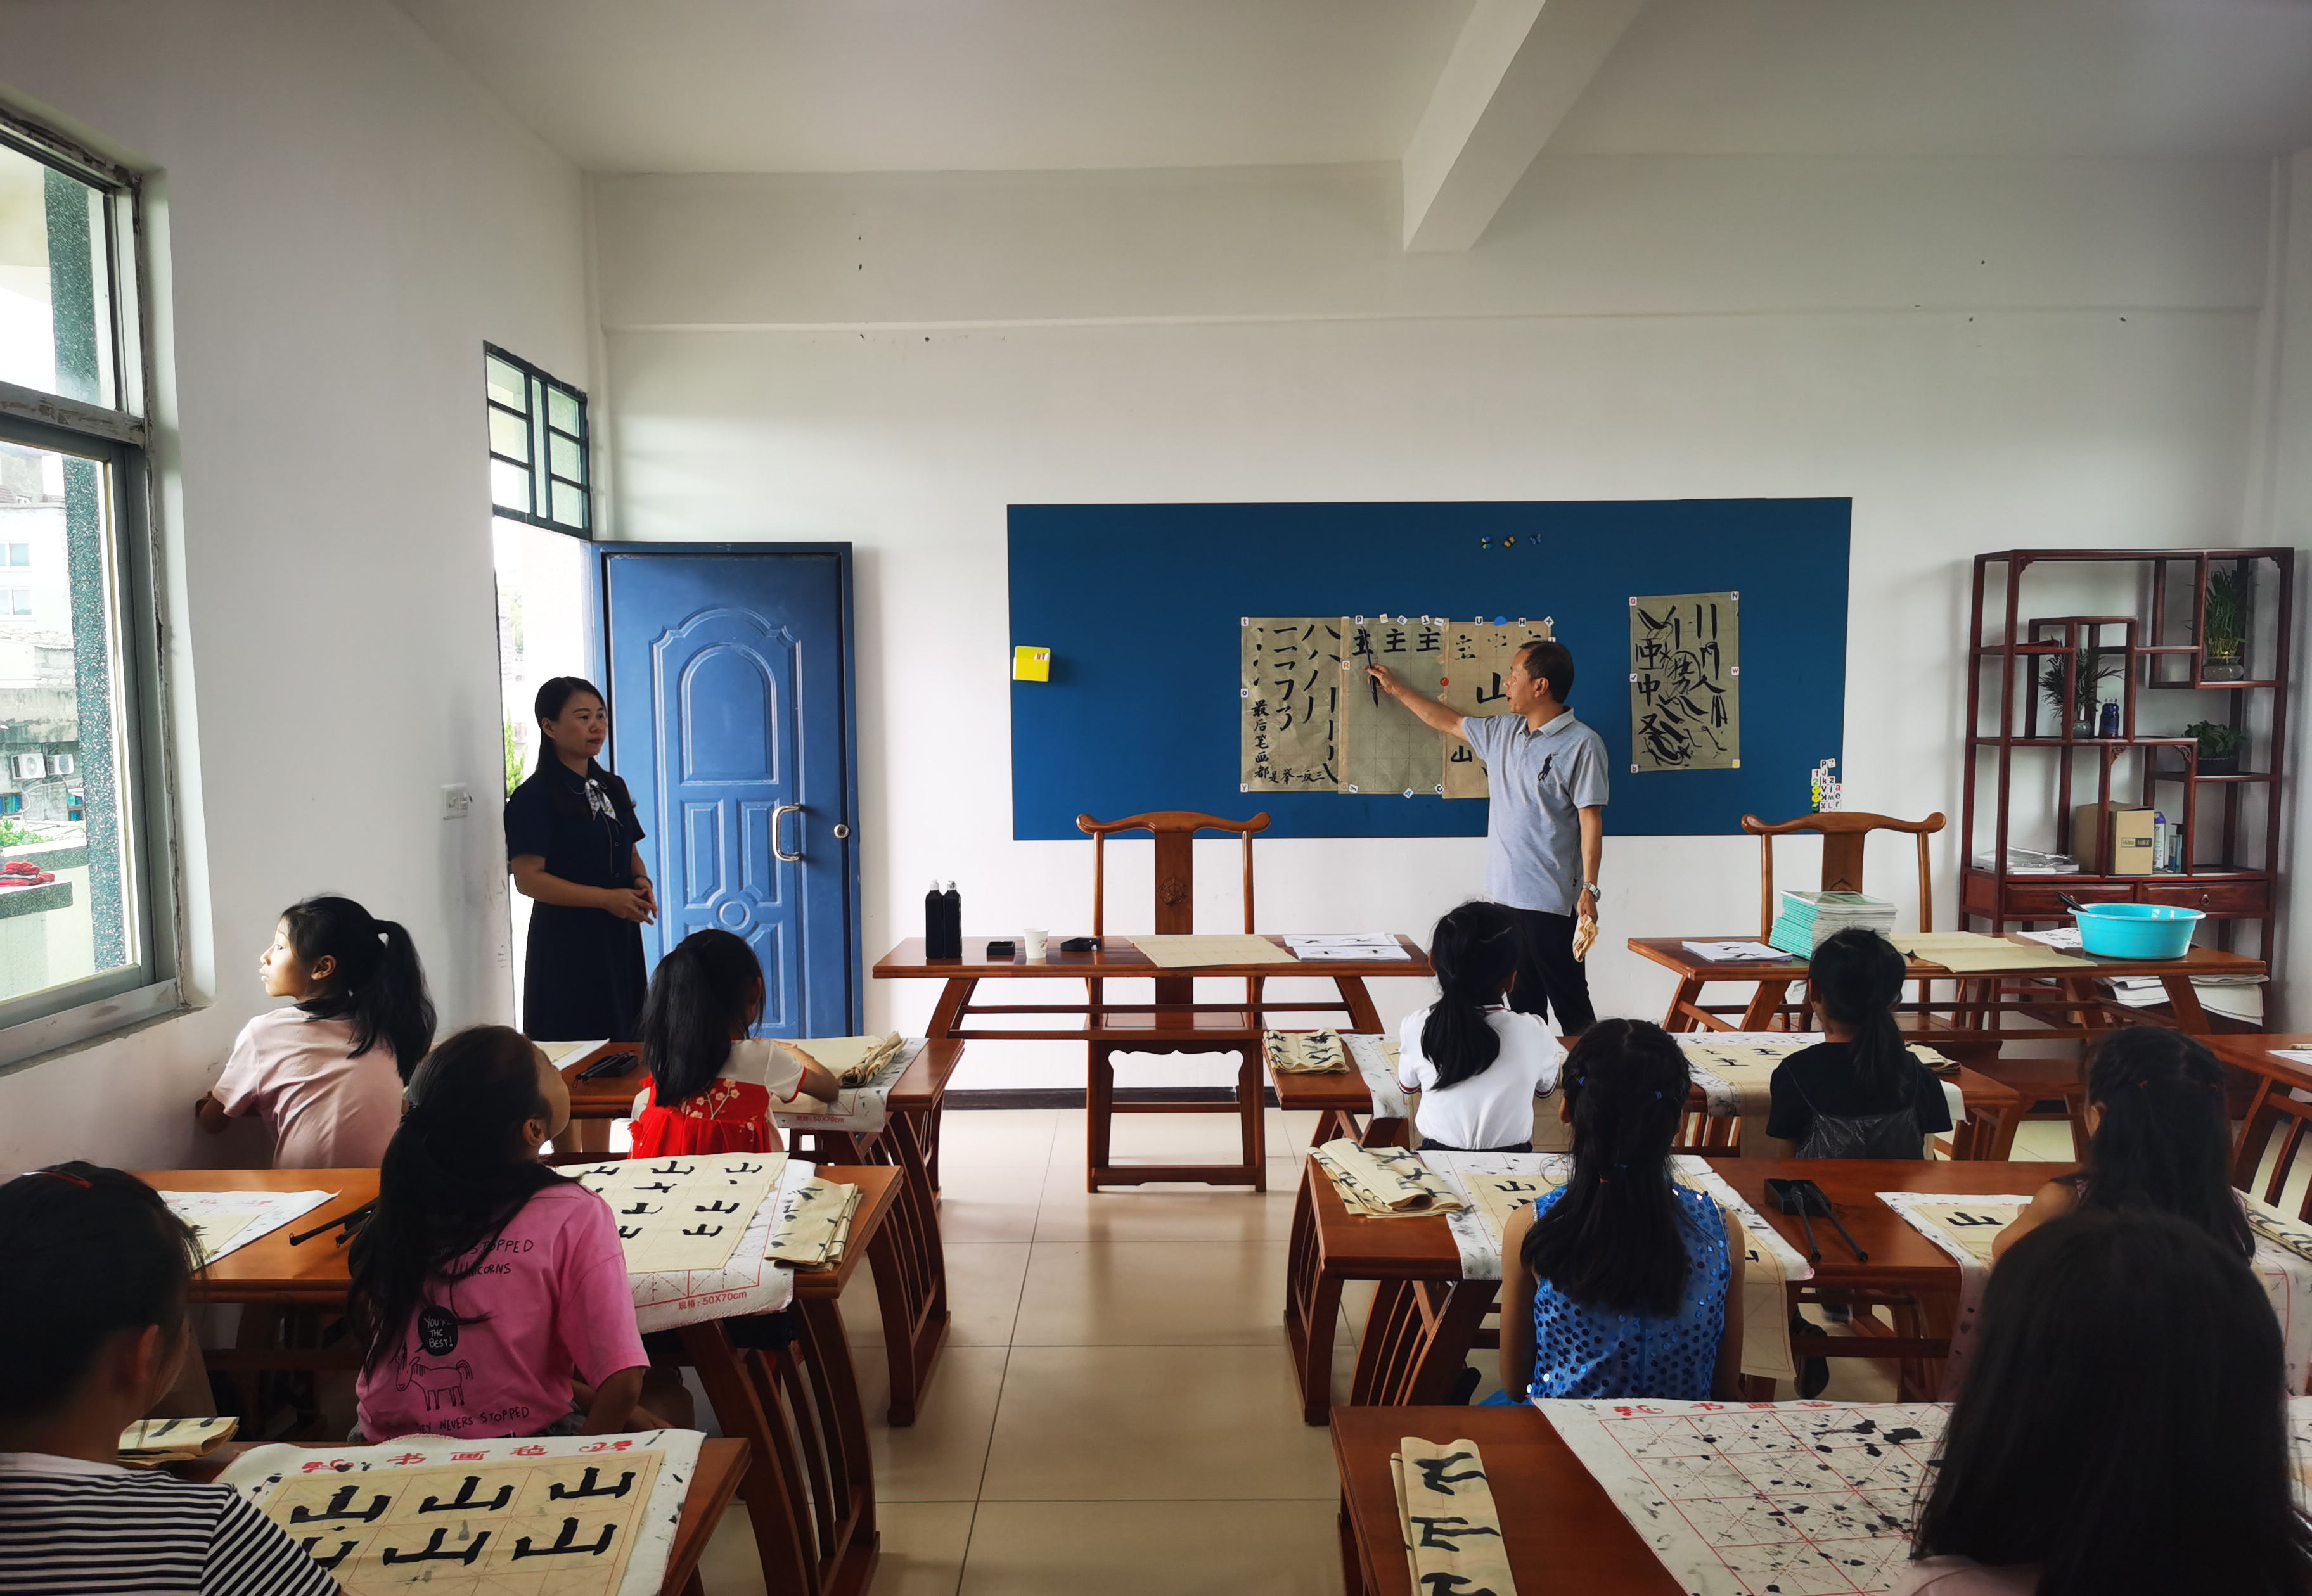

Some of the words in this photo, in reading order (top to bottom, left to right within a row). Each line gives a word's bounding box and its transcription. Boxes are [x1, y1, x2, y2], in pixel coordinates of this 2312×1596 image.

[1451, 745, 1473, 762] 山
[650, 1160, 695, 1175] 山
[723, 1162, 763, 1173] 山
[694, 1200, 740, 1214] 山
[682, 1223, 724, 1237] 山
[428, 1336, 453, 1348] BEST!
[480, 1406, 530, 1423] STOPPED
[289, 1485, 392, 1524] 山
[418, 1476, 516, 1514] 山
[549, 1467, 636, 1501] 山
[382, 1528, 492, 1566] 山
[511, 1517, 618, 1561] 山
